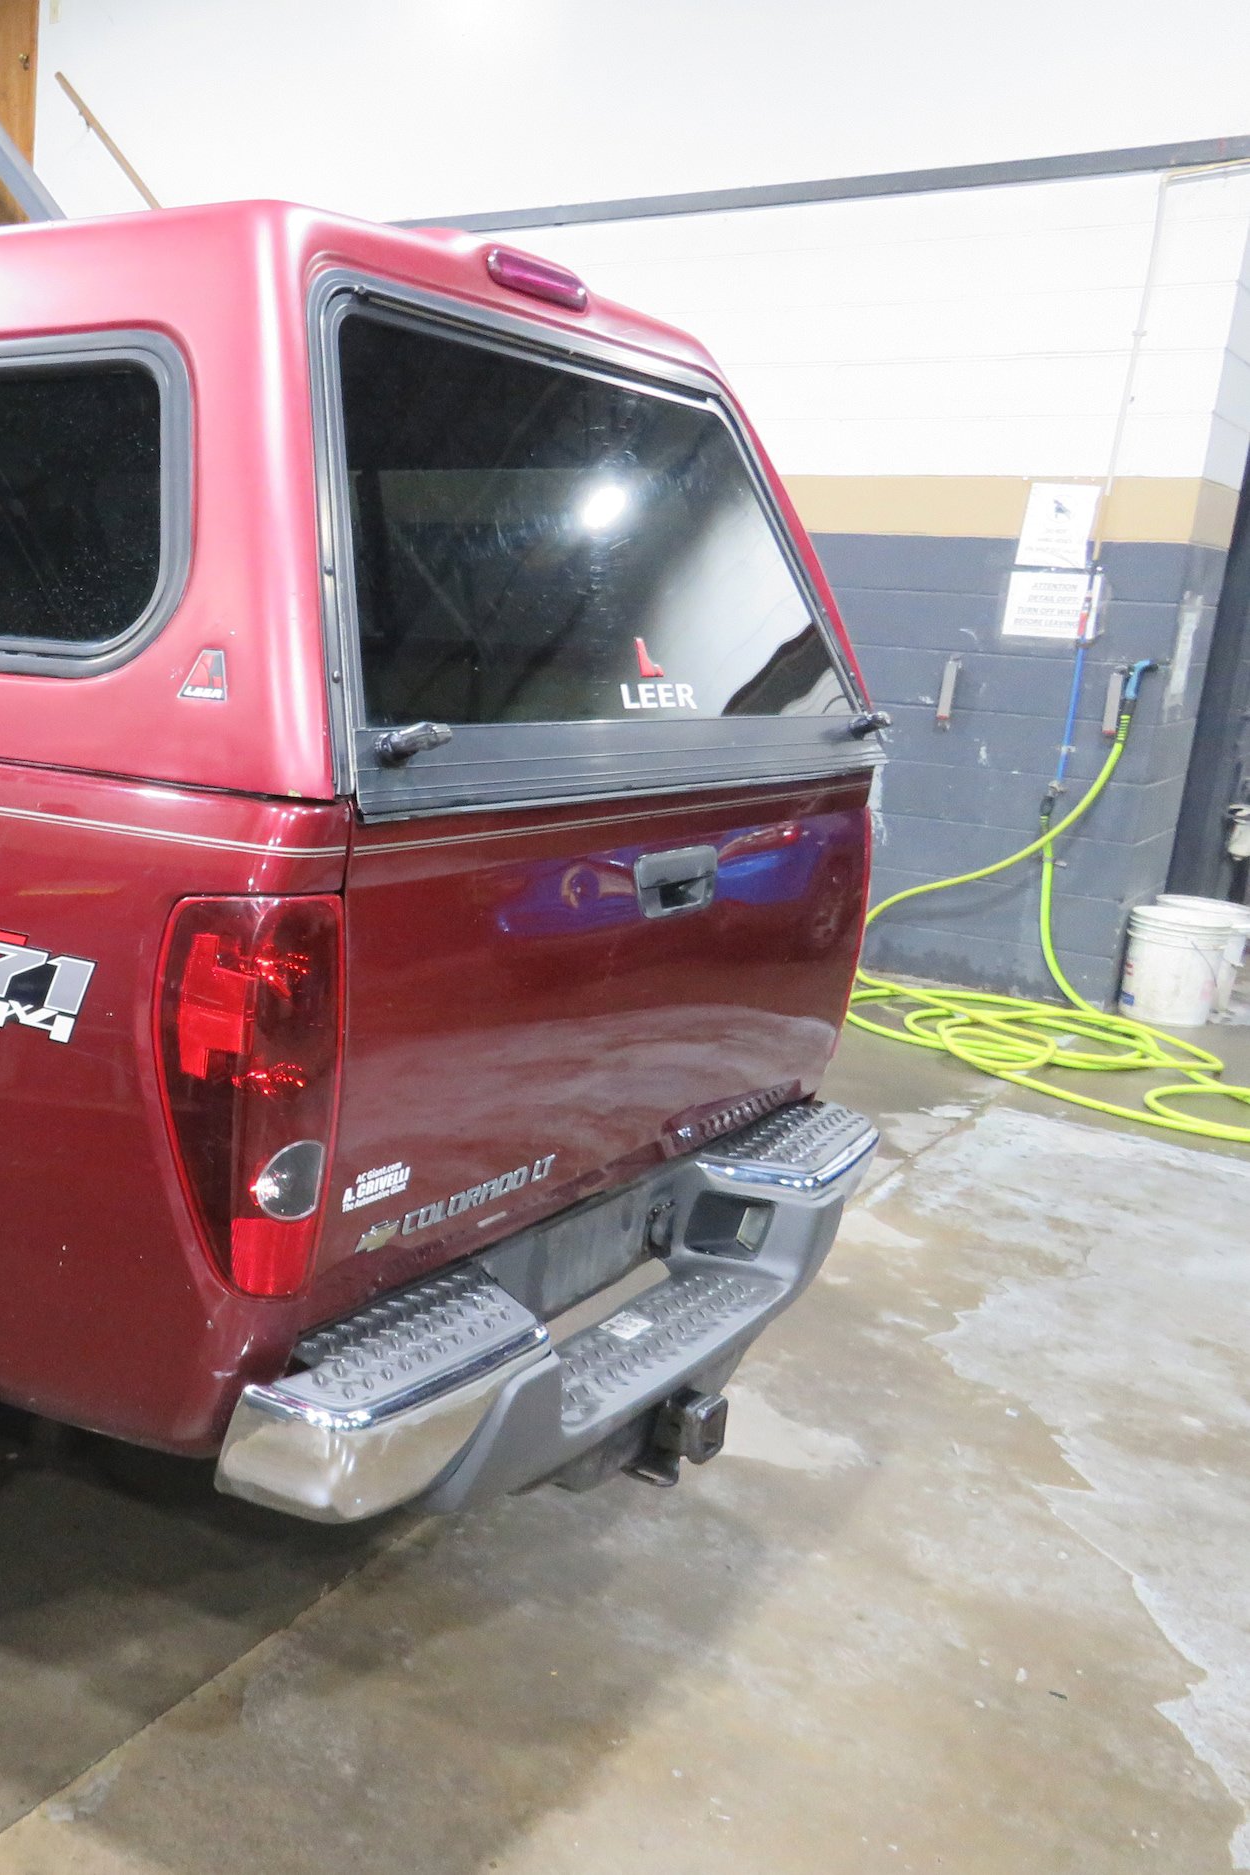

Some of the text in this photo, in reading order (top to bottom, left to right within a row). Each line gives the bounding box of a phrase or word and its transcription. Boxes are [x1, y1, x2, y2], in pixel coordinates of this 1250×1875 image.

[1032, 583, 1078, 591] ATTENTION
[1017, 606, 1080, 617] TURN OFF WATE
[1014, 618, 1043, 627] BEFORE
[620, 683, 698, 709] LEER
[342, 1166, 410, 1203] A. CRIVELLI
[402, 1153, 556, 1236] COLORADO LT
